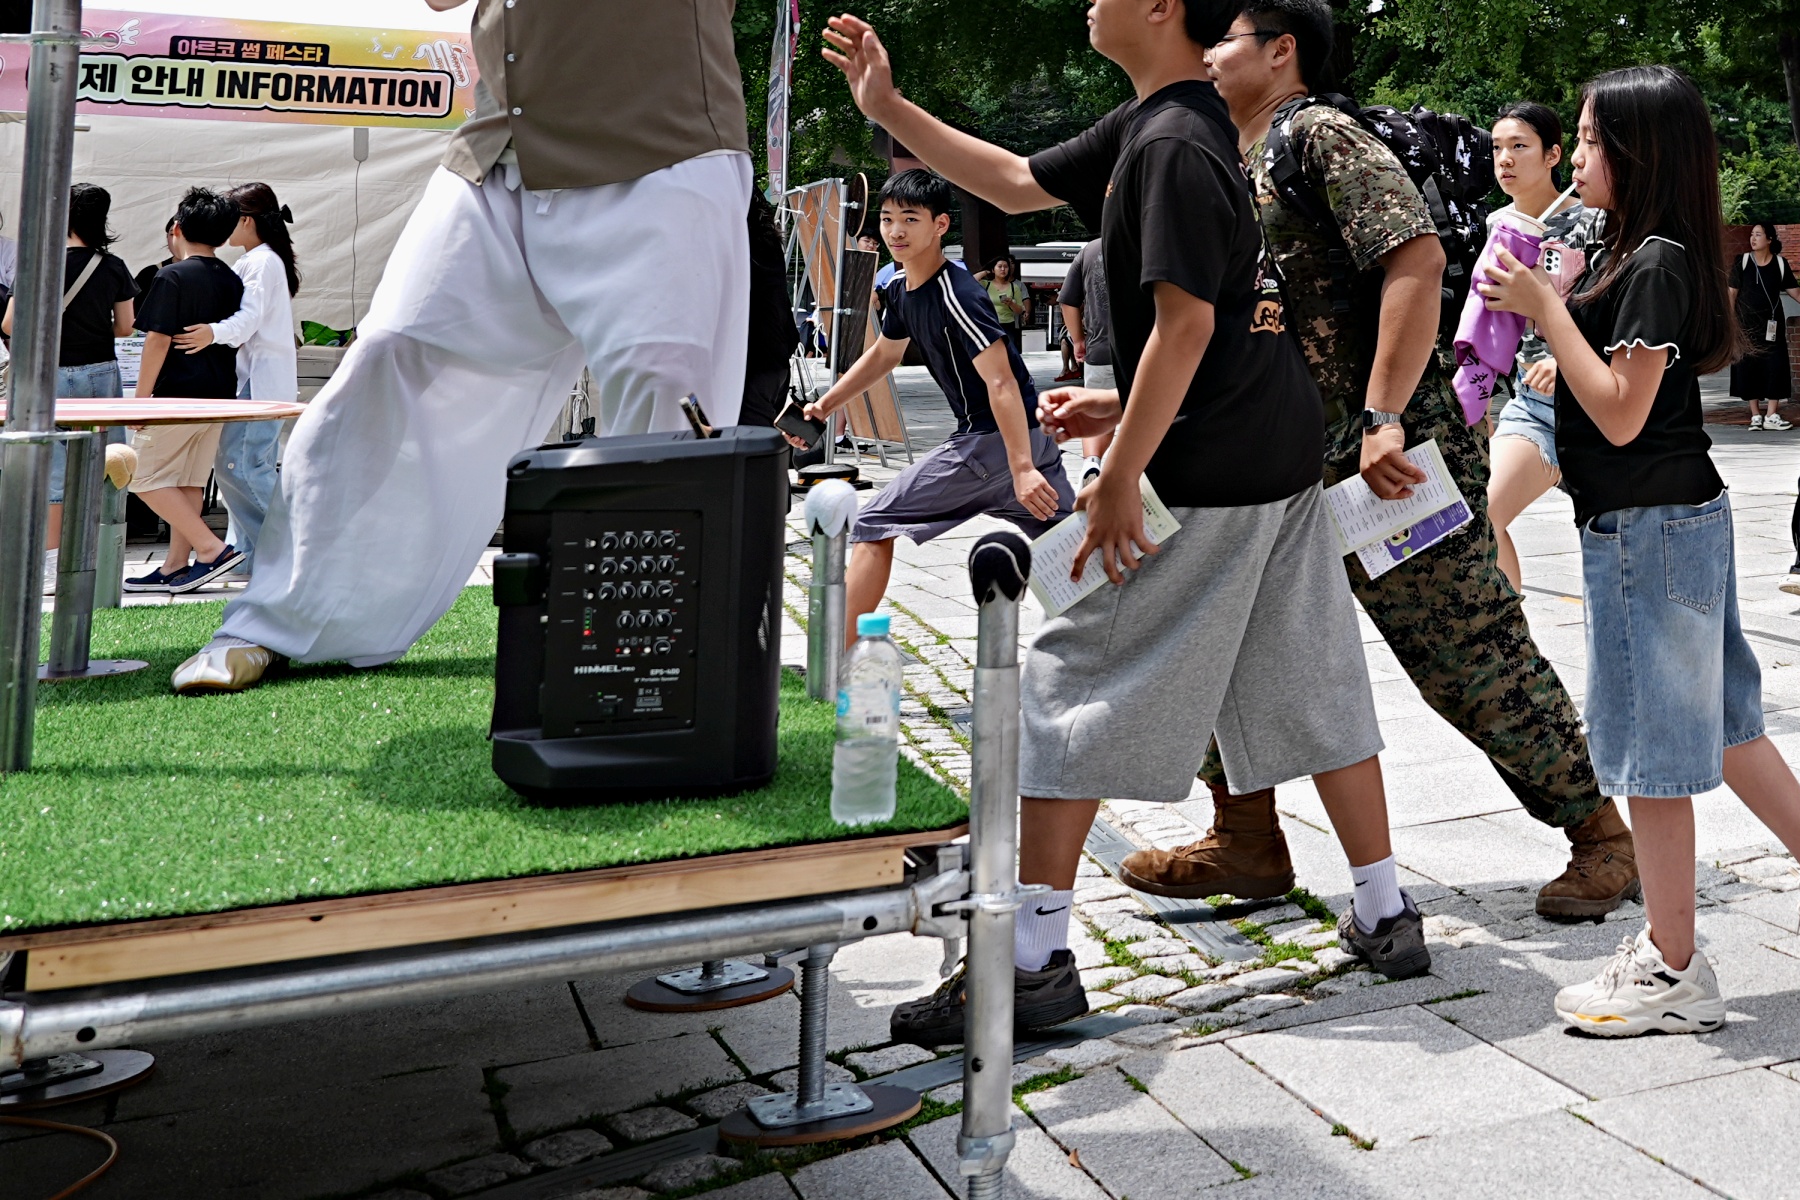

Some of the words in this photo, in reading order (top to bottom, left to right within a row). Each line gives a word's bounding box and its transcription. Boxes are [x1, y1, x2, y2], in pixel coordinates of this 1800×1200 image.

[178, 38, 235, 58] 아르코
[240, 42, 261, 60] 썸
[265, 43, 324, 63] 페스타
[79, 63, 118, 93] 제
[131, 65, 205, 98] 안내
[215, 69, 442, 108] INFORMATION
[573, 664, 621, 675] HIMMEL
[1634, 979, 1654, 987] FILA
